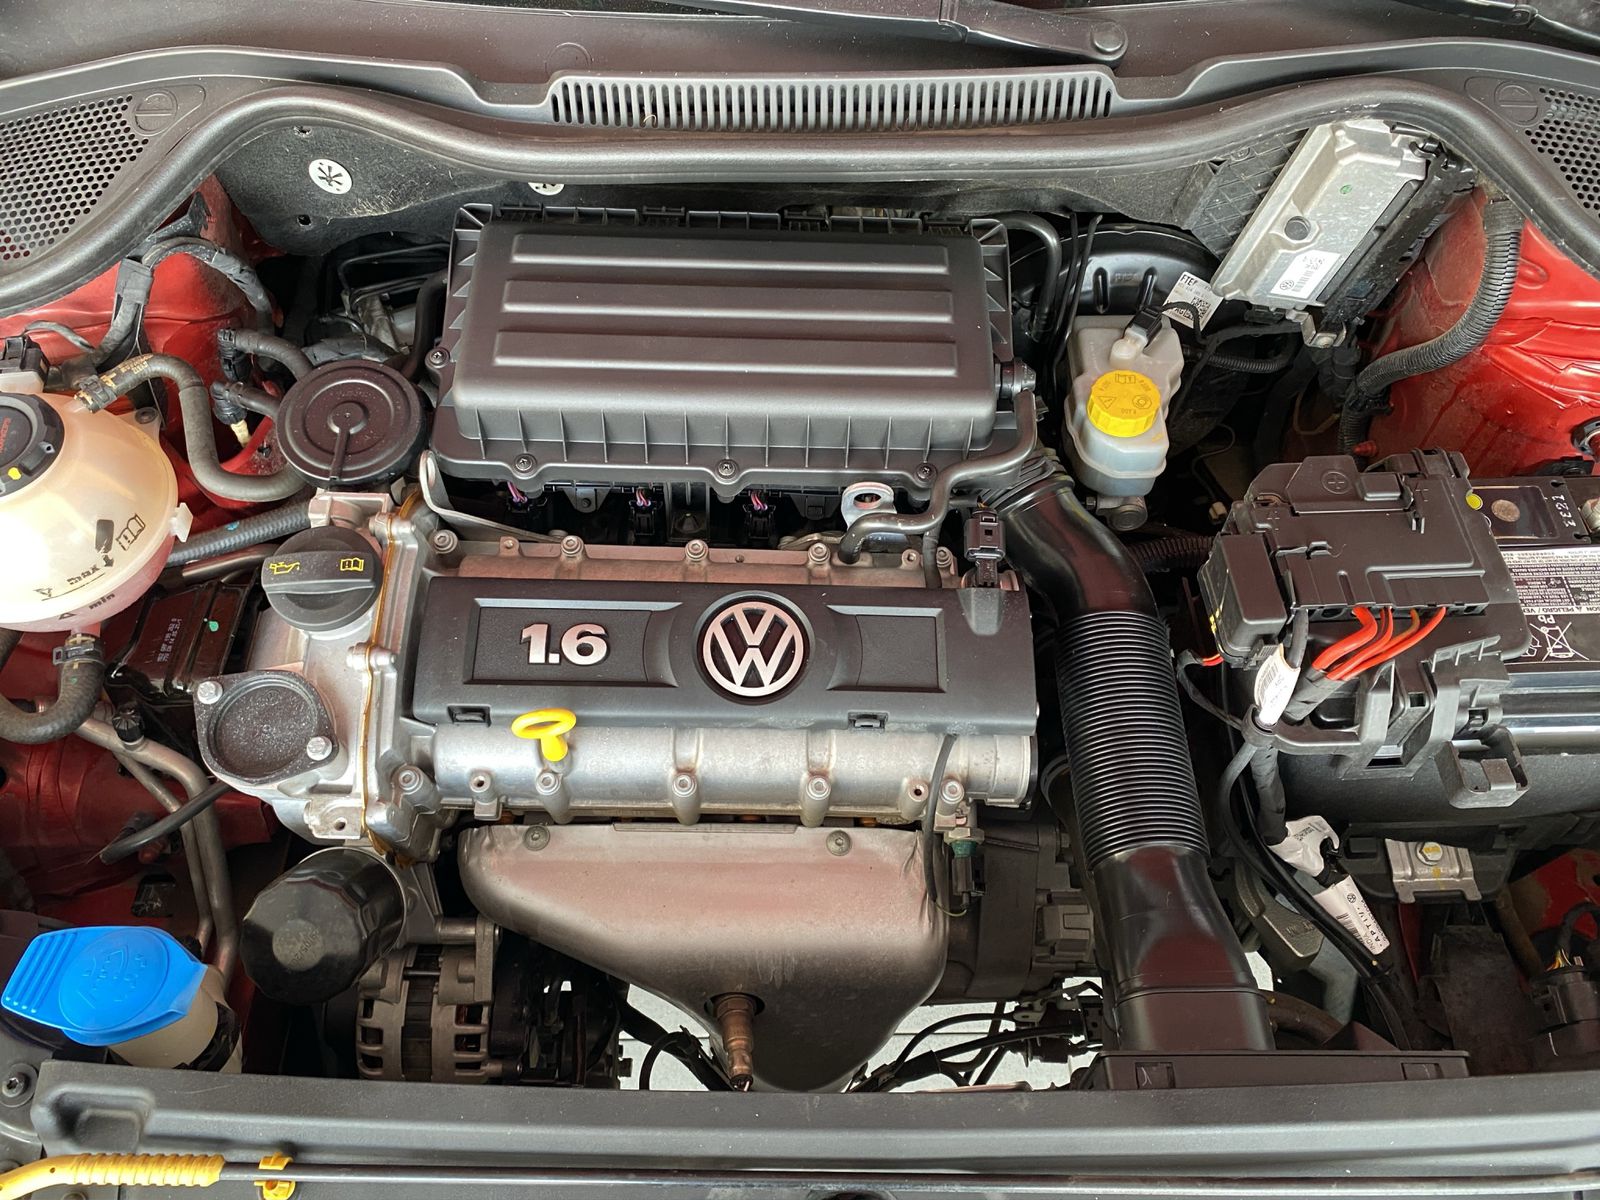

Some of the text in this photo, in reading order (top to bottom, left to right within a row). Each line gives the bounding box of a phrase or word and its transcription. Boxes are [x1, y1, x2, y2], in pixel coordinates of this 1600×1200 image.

[89, 593, 115, 609] min
[1538, 615, 1556, 624] Pb
[520, 622, 608, 665] 1.6
